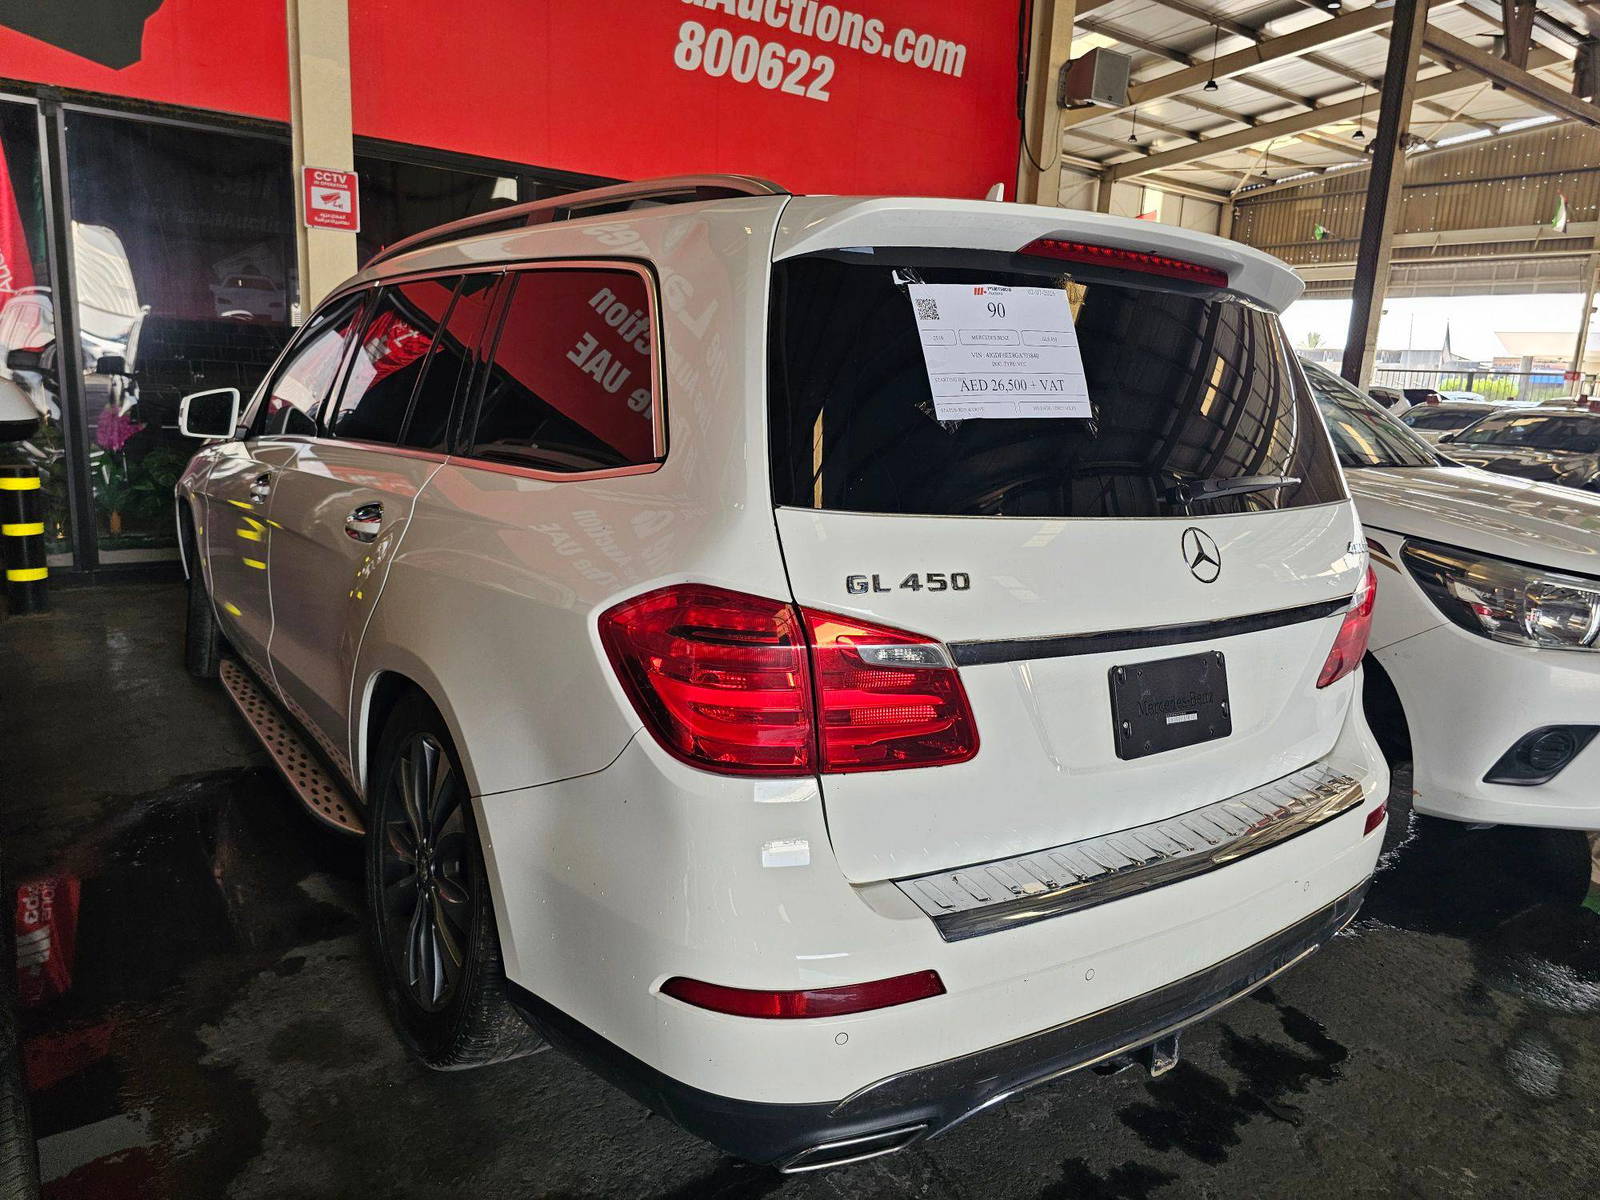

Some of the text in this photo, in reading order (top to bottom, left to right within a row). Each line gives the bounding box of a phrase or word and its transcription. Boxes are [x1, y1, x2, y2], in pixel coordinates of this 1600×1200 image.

[681, 0, 967, 77] uctions.com
[674, 20, 835, 102] 800622
[314, 171, 347, 184] CCTV
[987, 301, 1006, 318] 90
[960, 379, 988, 392] AED
[991, 379, 1027, 392] 26,500
[1040, 379, 1064, 392] VAT
[846, 572, 971, 595] GL 450
